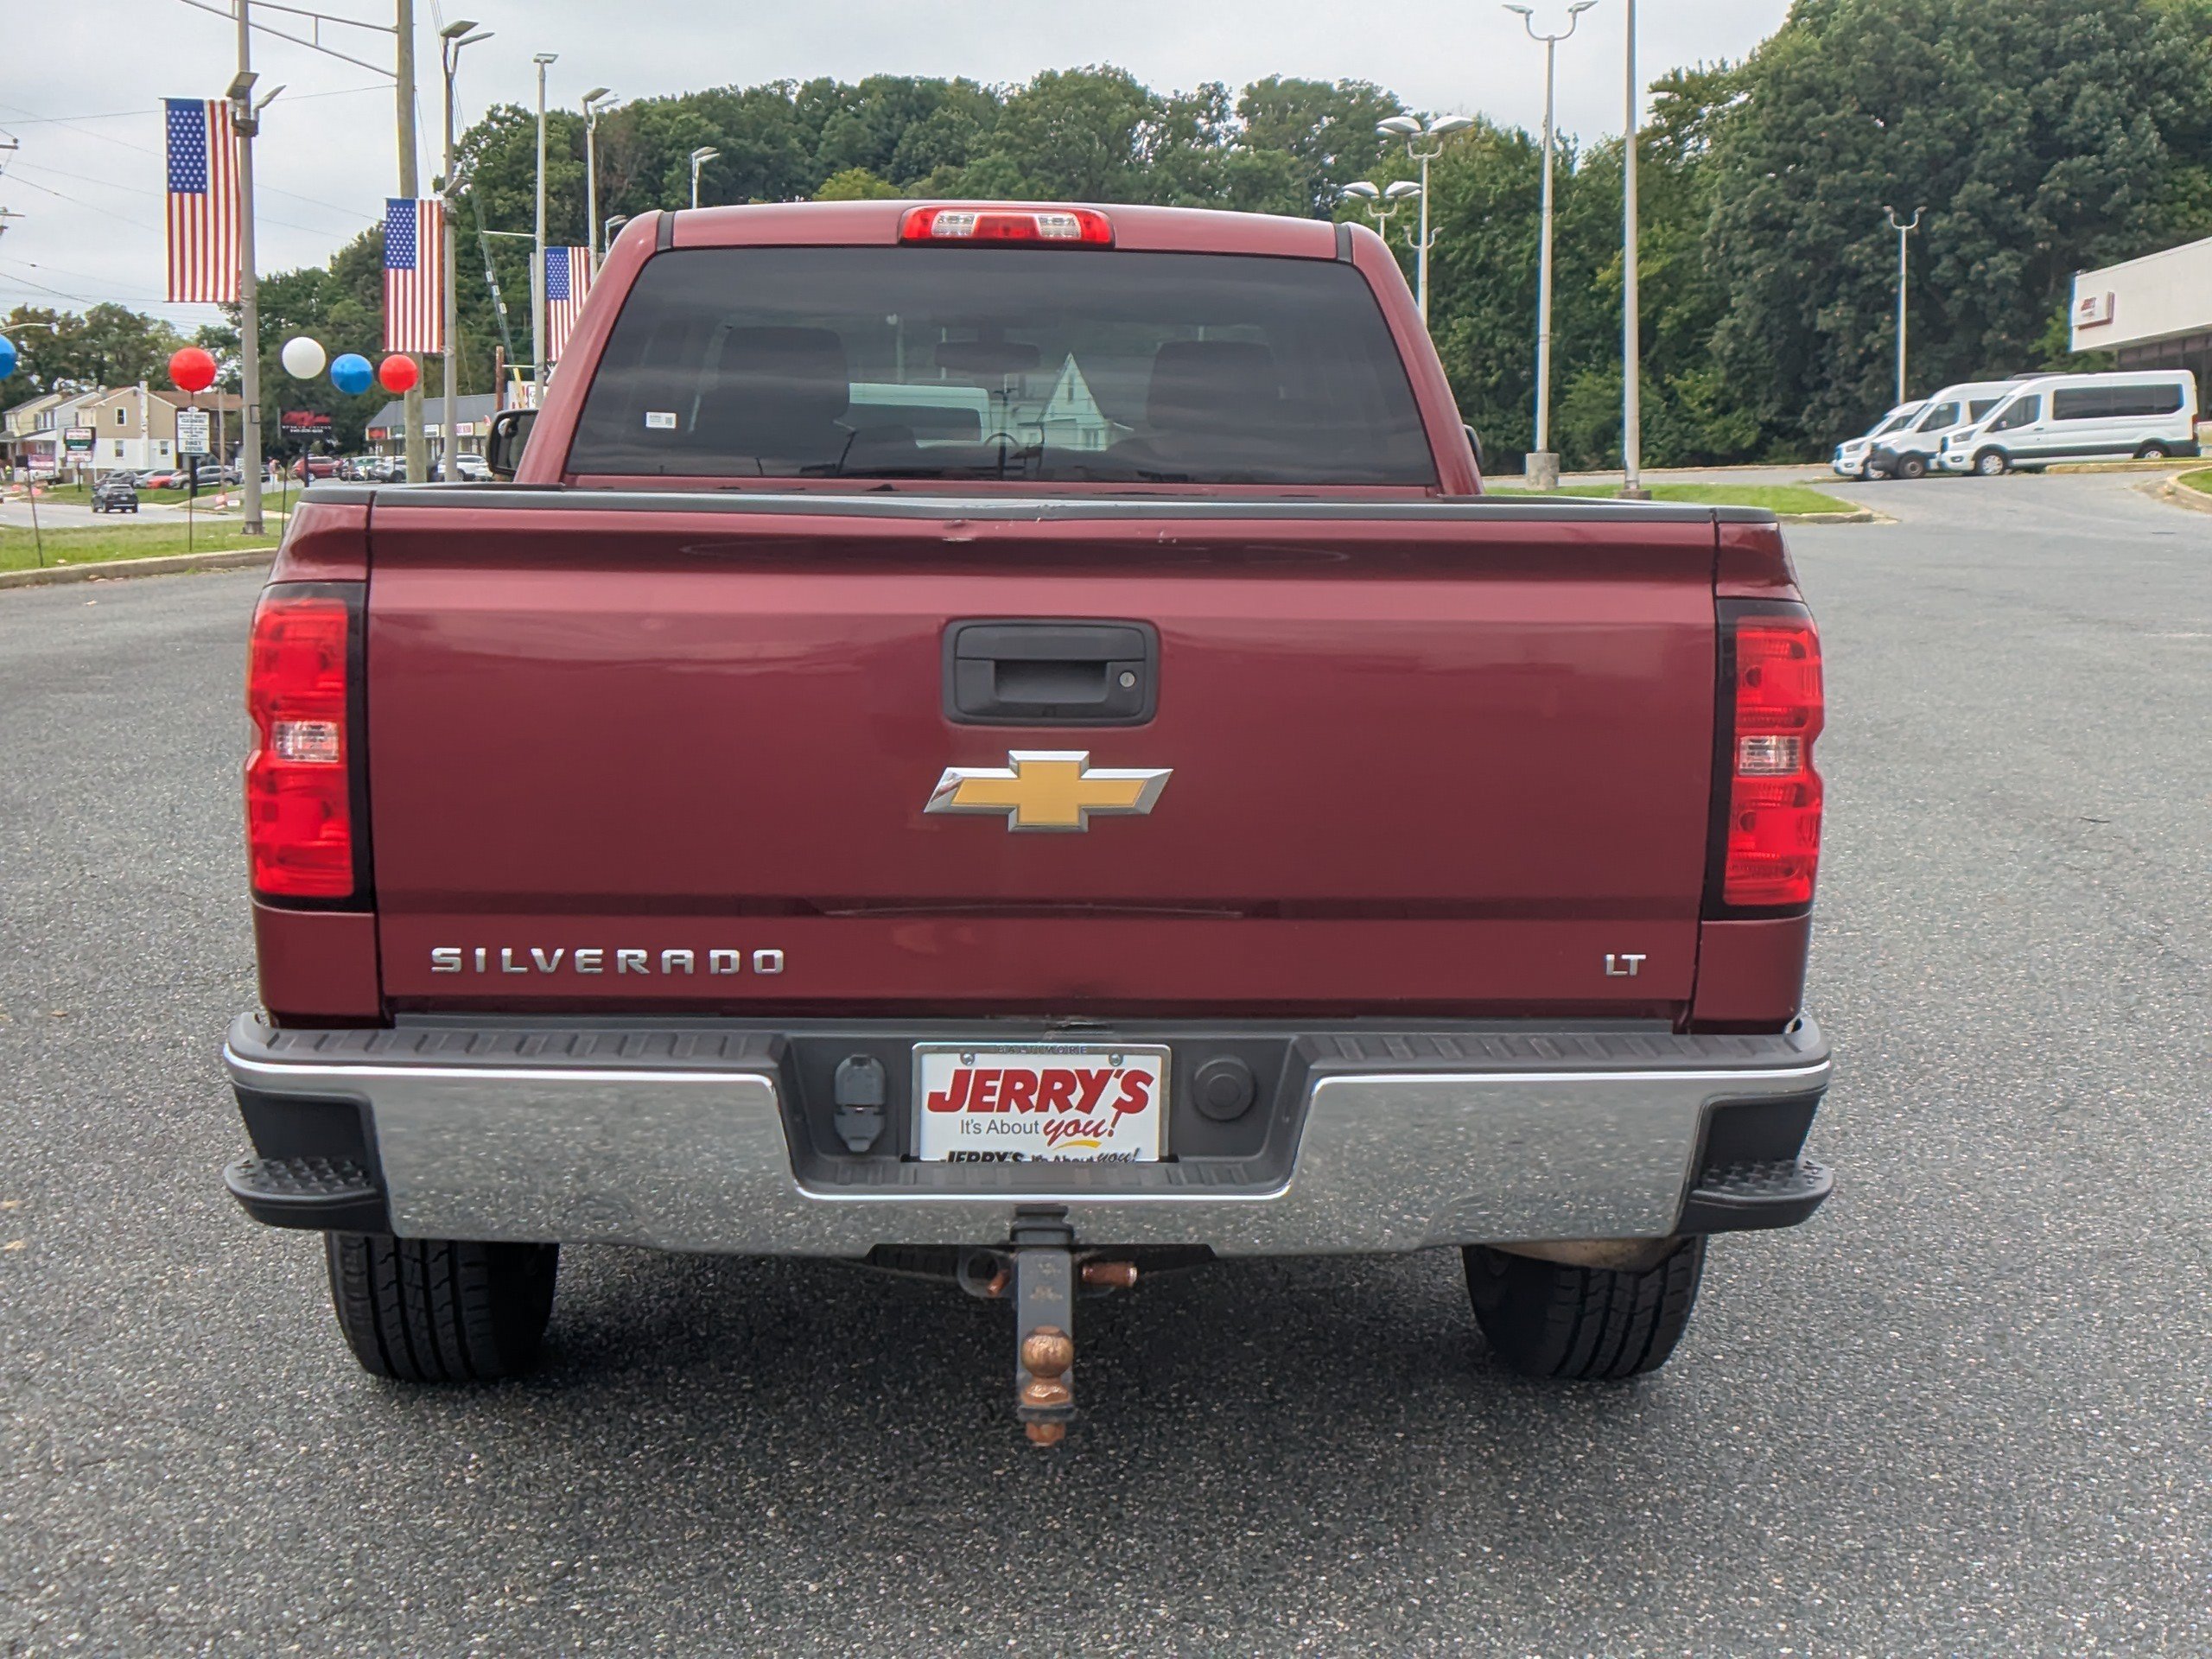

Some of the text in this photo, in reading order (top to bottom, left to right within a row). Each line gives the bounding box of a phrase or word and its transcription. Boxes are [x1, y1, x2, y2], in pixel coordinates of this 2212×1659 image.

[431, 947, 785, 975] SILVERADO
[1605, 954, 1647, 976] LT
[927, 1069, 1154, 1115] JERRY'S
[960, 1109, 1122, 1147] It's About you!
